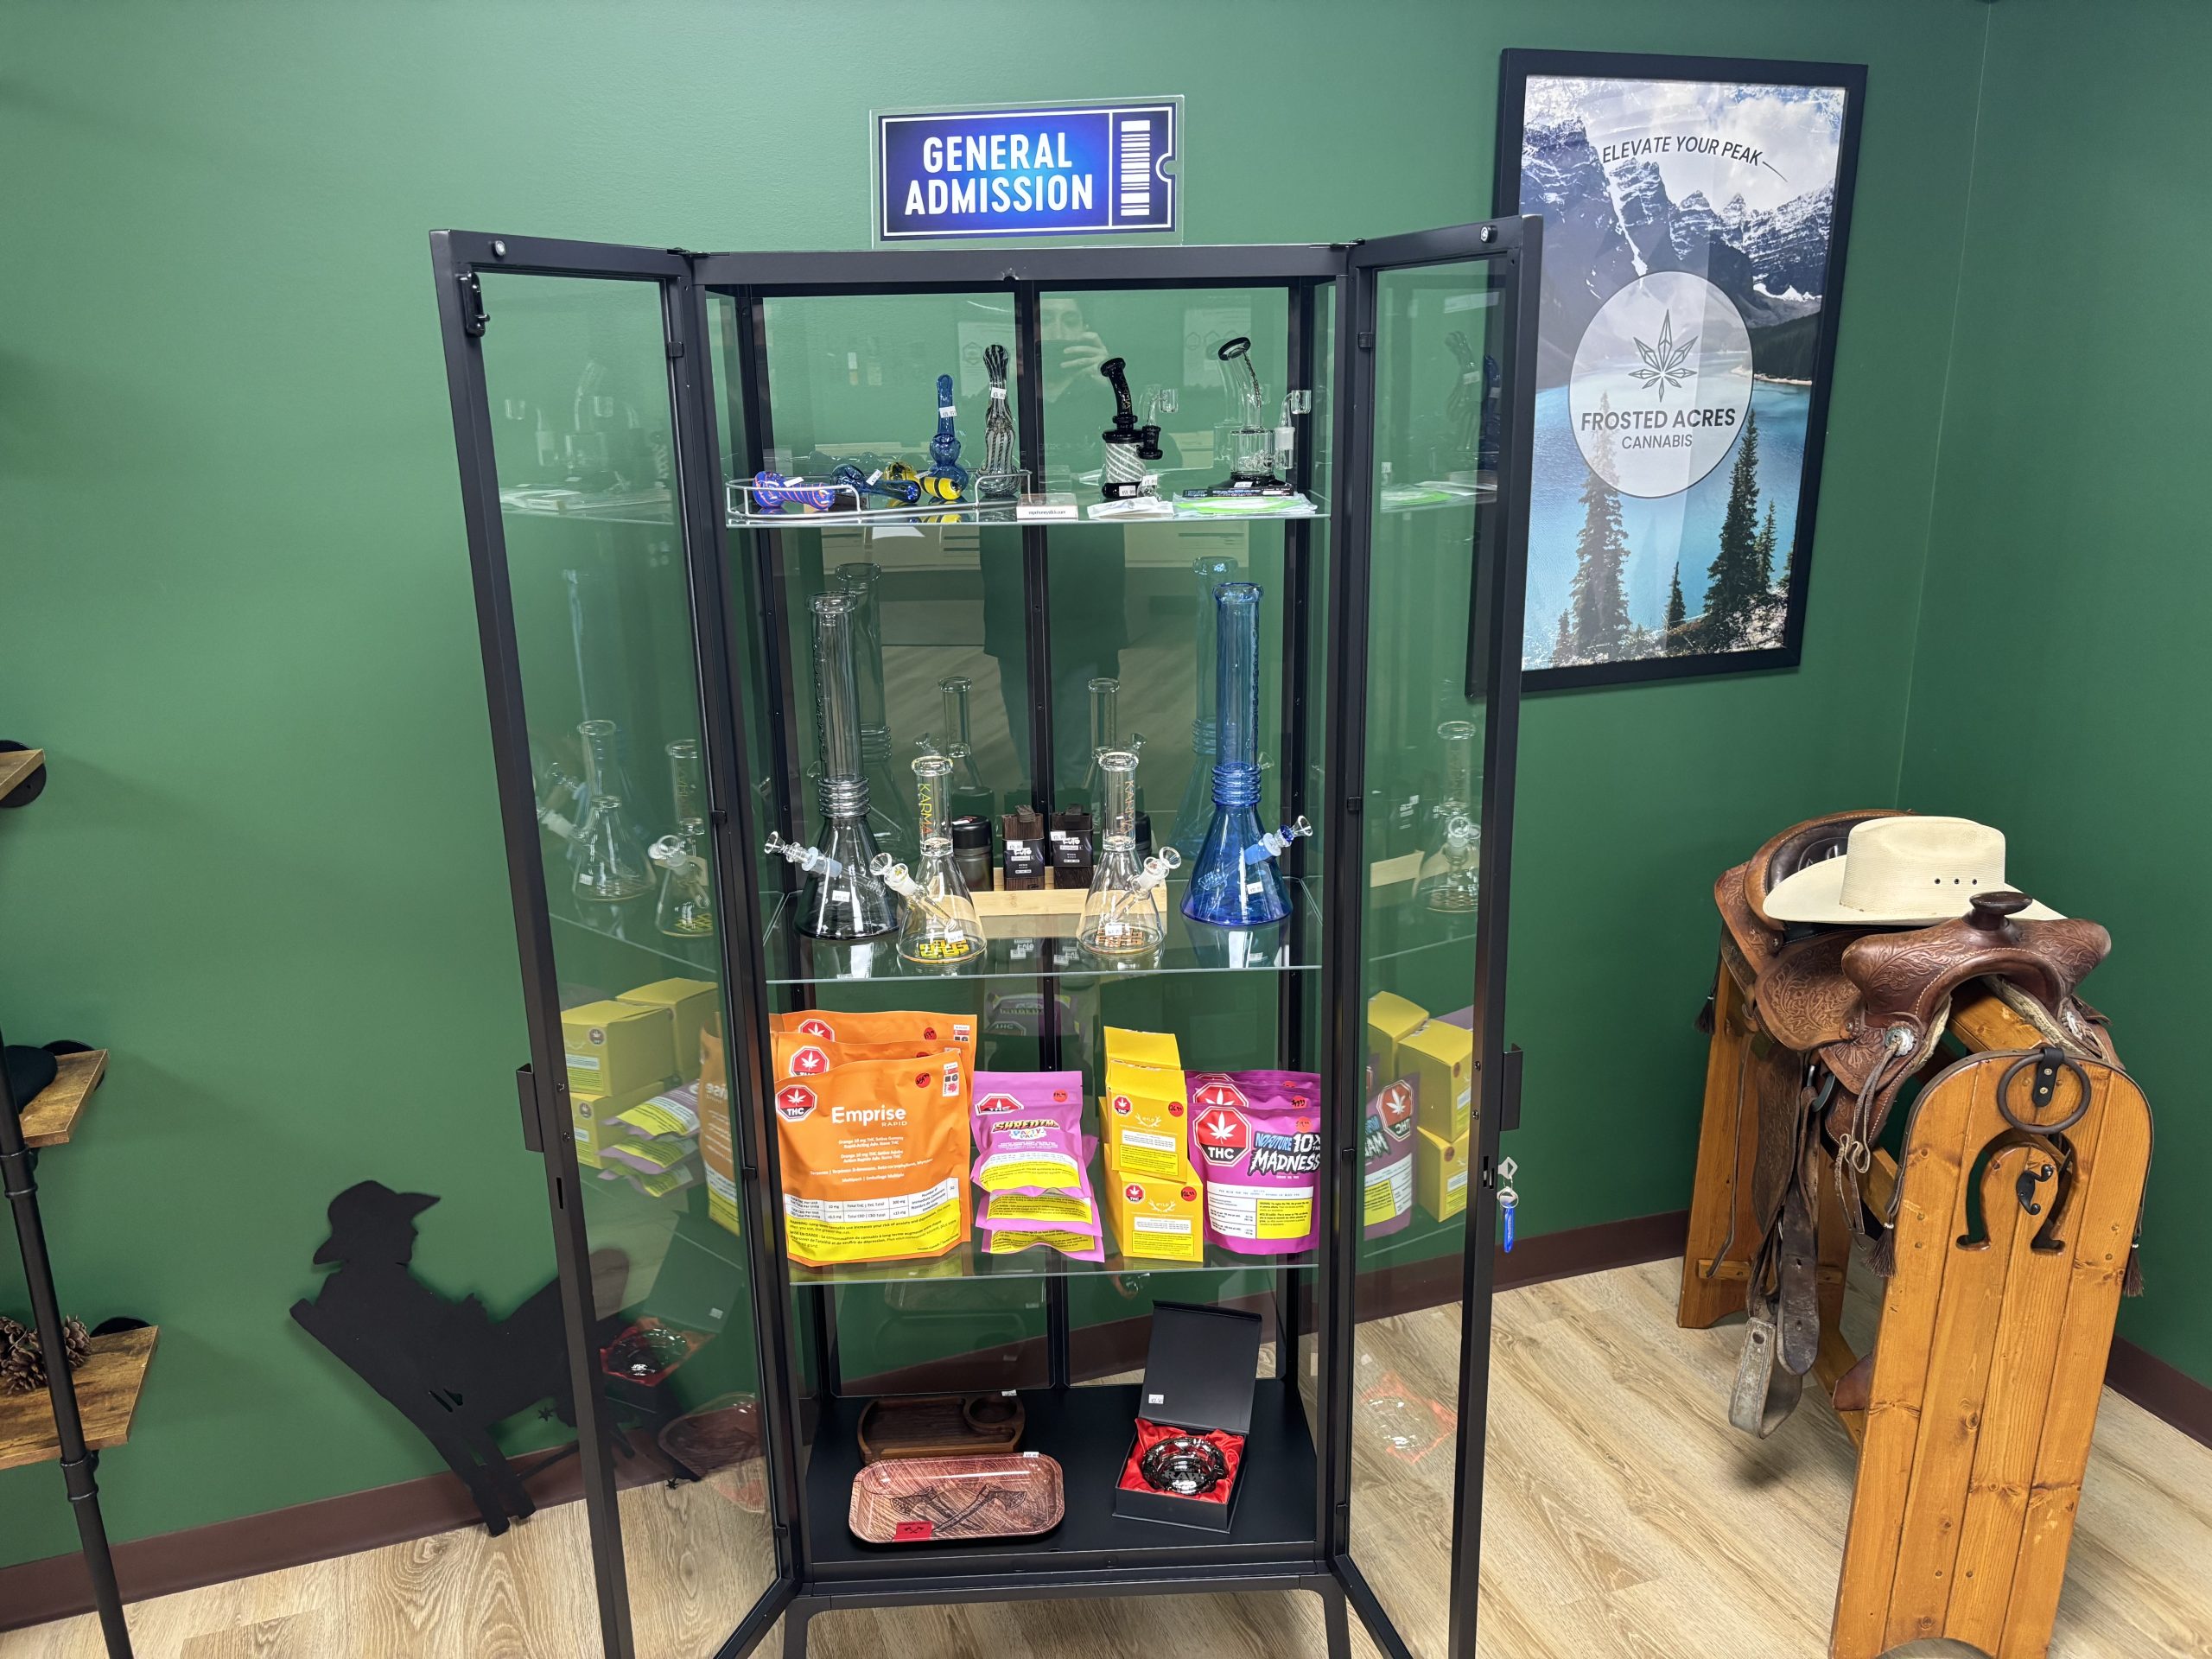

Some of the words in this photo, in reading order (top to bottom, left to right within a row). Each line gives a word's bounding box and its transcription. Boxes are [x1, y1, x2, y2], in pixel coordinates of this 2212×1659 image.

[923, 132, 1072, 173] GENERAL
[1602, 136, 1672, 164] ELEVATE
[1676, 136, 1719, 156] YOUR
[1720, 141, 1763, 167] PEAK
[905, 174, 1093, 216] ADMISSION
[1581, 410, 1668, 431] FROSTED
[1672, 408, 1736, 429] ACRES
[1621, 435, 1693, 449] CANNABIS
[918, 783, 935, 836] KARMA
[1124, 779, 1135, 836] KARMA
[786, 1107, 804, 1116] THC
[831, 1104, 907, 1126] Emprise
[1207, 1147, 1234, 1160] THC
[1249, 1148, 1320, 1174] MADNESS
[1162, 1470, 1206, 1484] RAW
